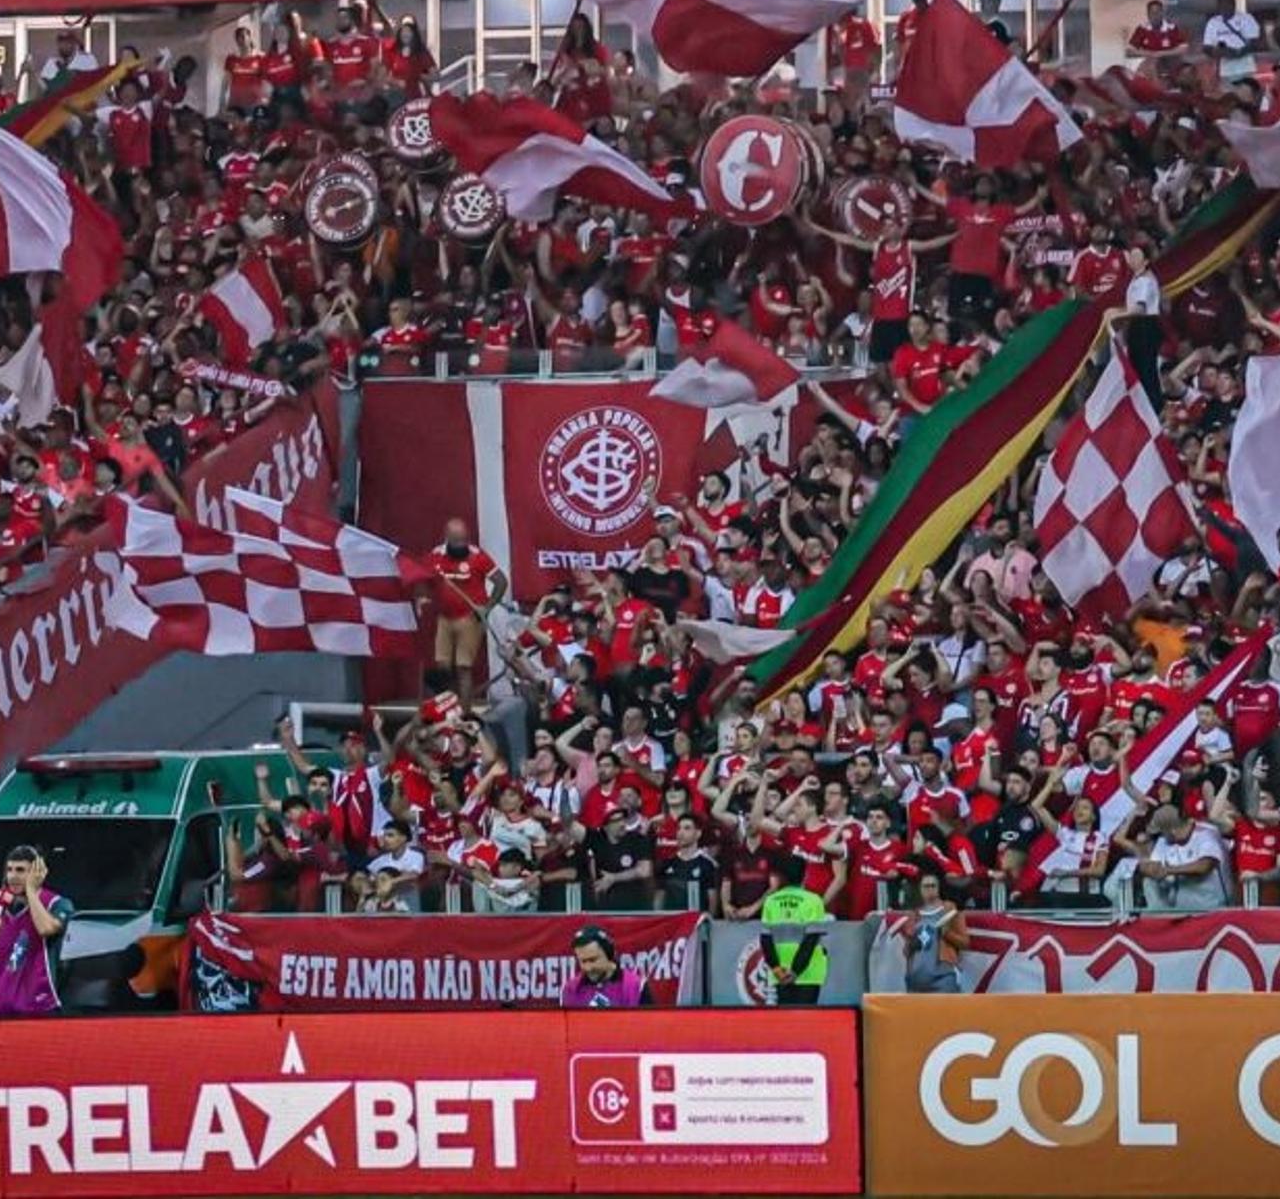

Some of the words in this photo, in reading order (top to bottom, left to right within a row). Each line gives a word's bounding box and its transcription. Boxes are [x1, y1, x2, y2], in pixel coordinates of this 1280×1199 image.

[17, 801, 107, 817] Unimed
[279, 954, 338, 996] ESTE
[344, 957, 416, 999] AMOR
[424, 953, 473, 1000] NÃO
[479, 957, 577, 1001] NASCEU
[919, 1031, 1179, 1148] GOL
